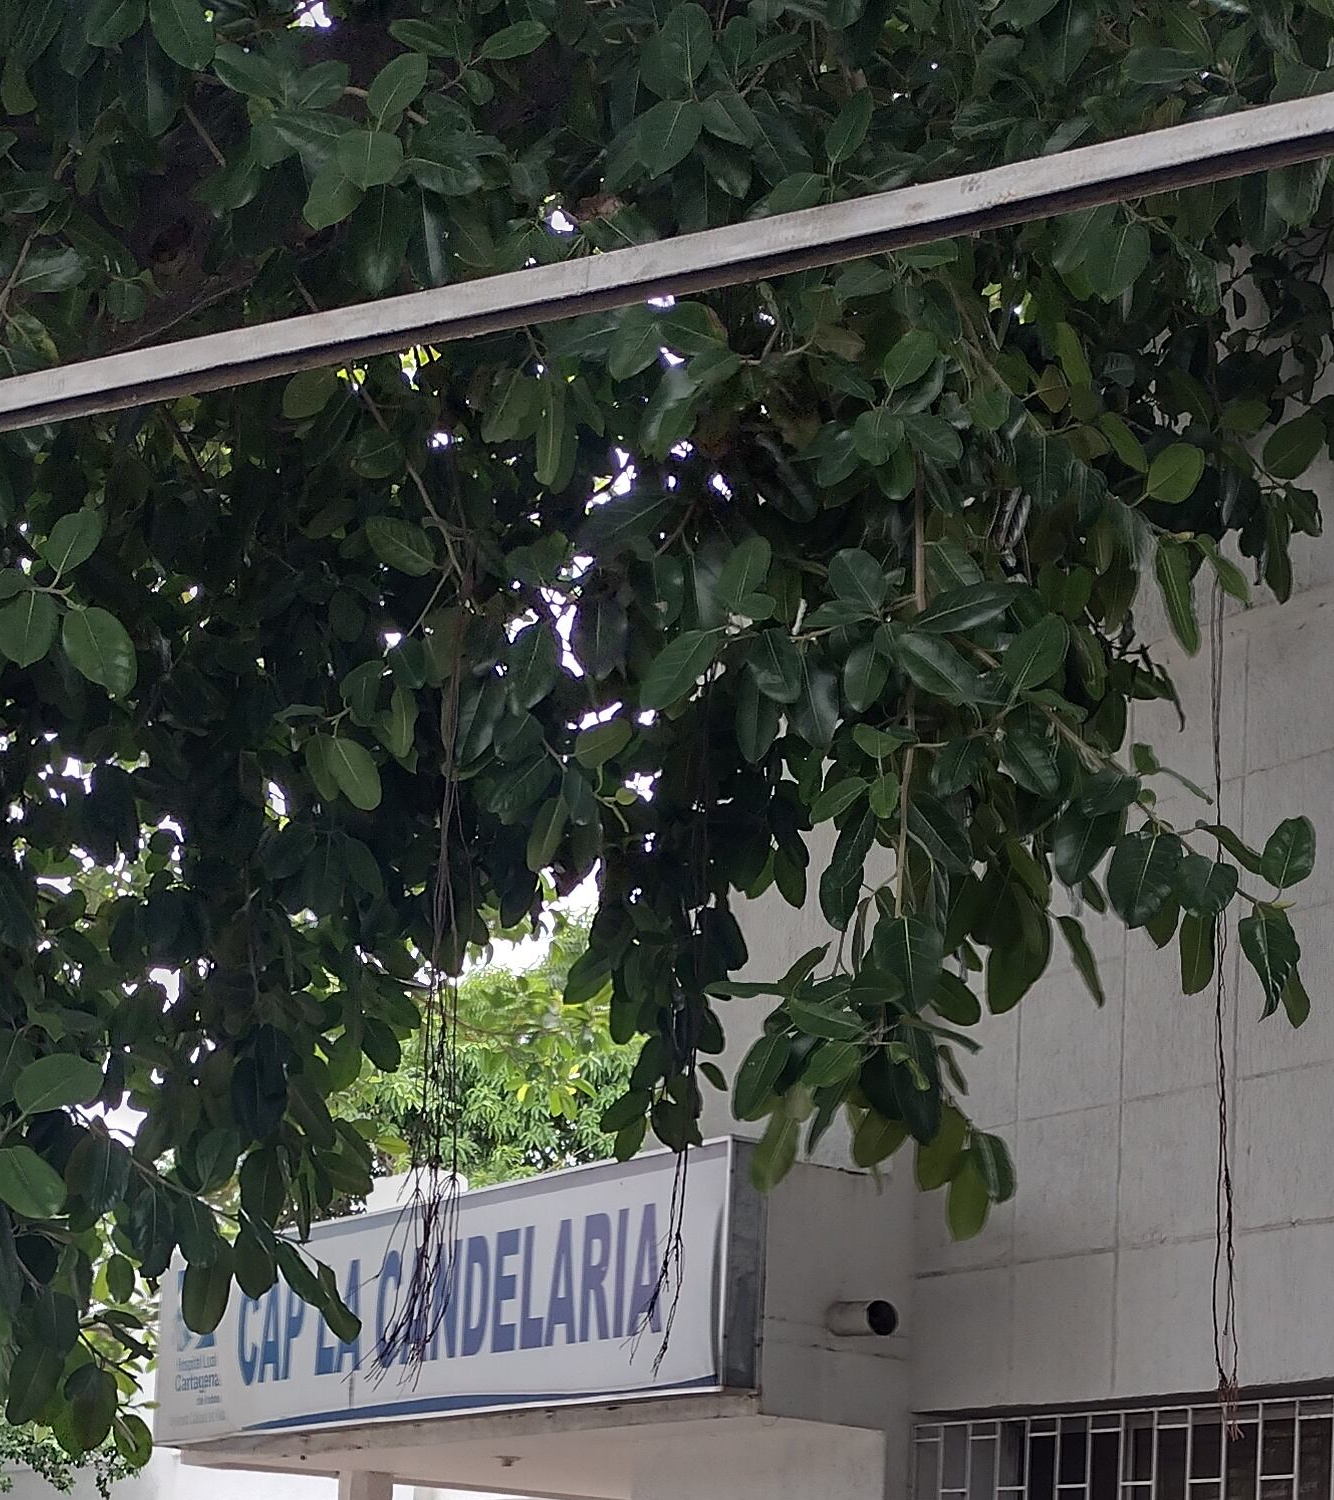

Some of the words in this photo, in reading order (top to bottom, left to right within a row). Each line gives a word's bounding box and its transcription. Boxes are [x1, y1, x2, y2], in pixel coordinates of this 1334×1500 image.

[238, 1280, 305, 1386] CAP
[375, 1203, 662, 1369] CANDELARIA
[175, 1373, 220, 1393] Cartagena
